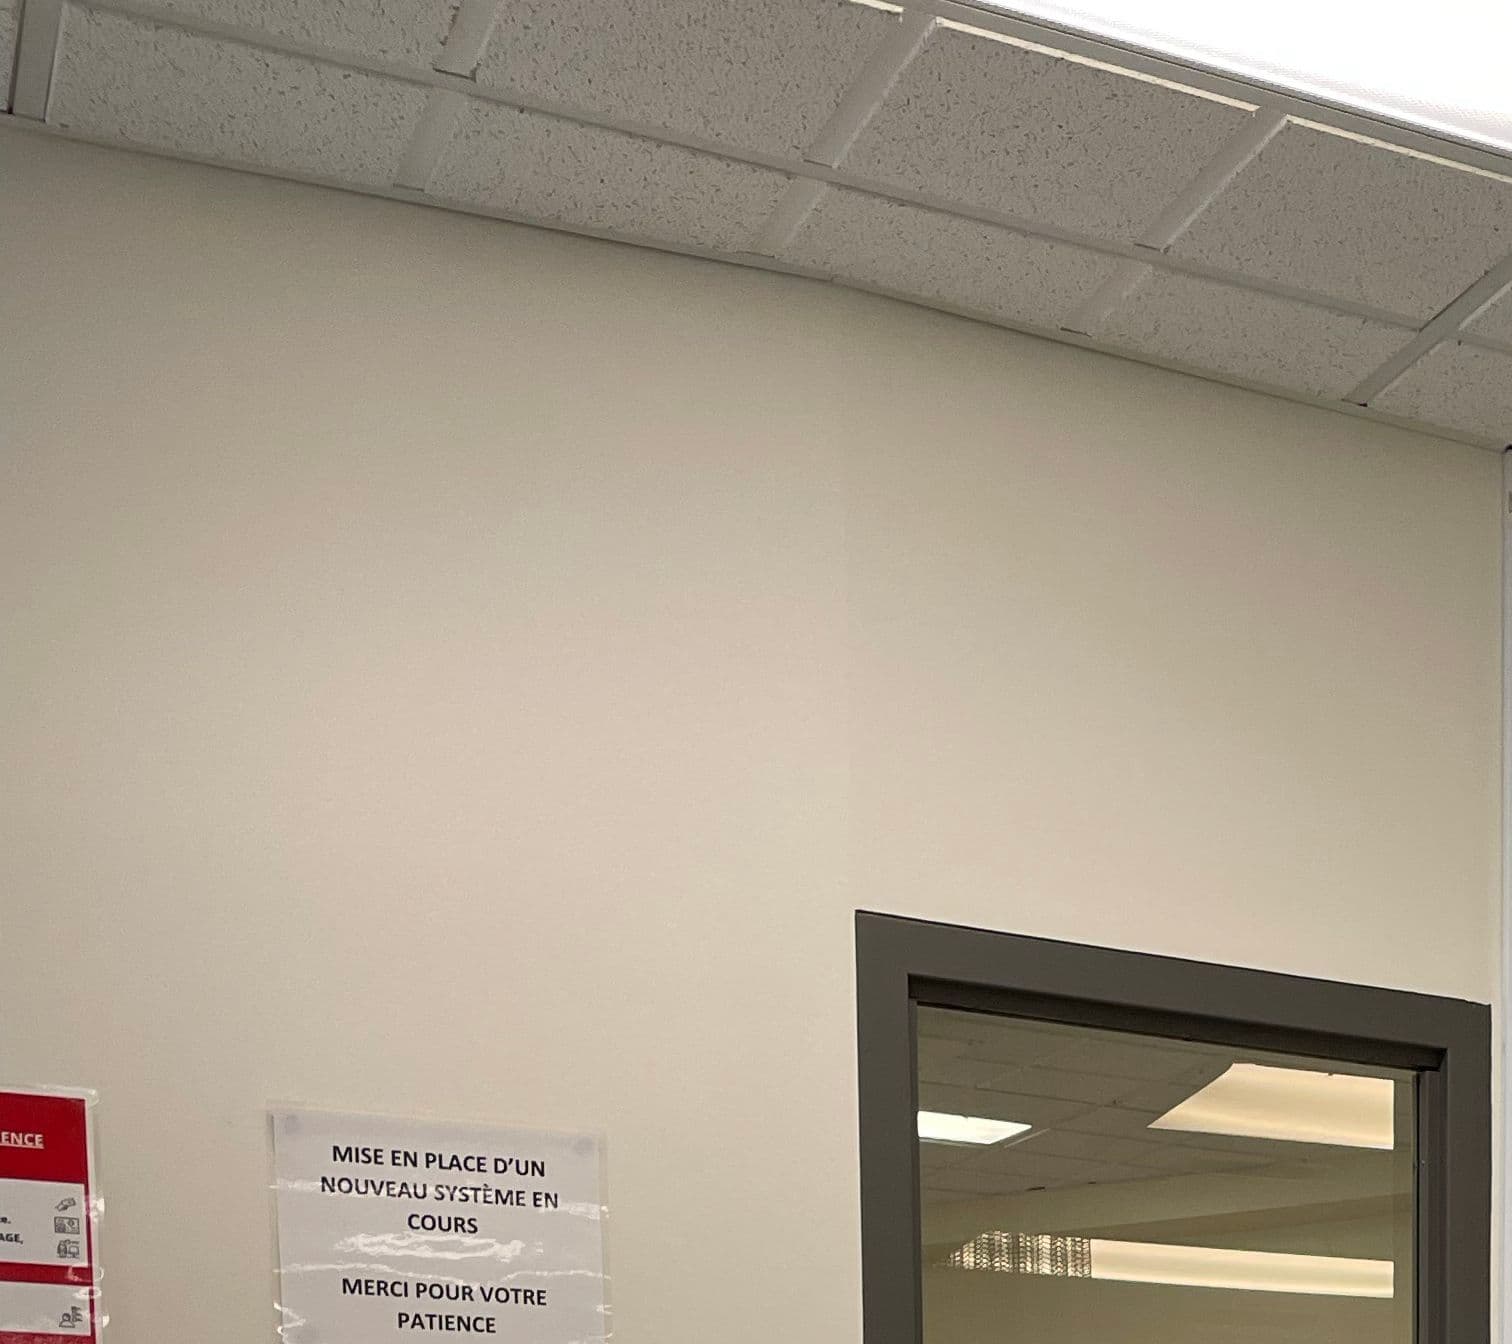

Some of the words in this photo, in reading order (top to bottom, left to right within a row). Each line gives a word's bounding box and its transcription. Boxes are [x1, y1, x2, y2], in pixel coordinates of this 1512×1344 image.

[332, 1145, 384, 1165] MISE
[391, 1150, 418, 1168] EN
[425, 1153, 487, 1173] PLACE
[494, 1157, 546, 1178] D'UN
[320, 1176, 427, 1199] NOUVEAU
[434, 1183, 527, 1207] SYSTÈME
[533, 1191, 559, 1208] EN
[407, 1213, 478, 1234] COURS
[342, 1278, 408, 1298] MERCI
[416, 1283, 474, 1302] POUR
[480, 1286, 547, 1306] VOTRE
[397, 1312, 496, 1333] PATIENCE
